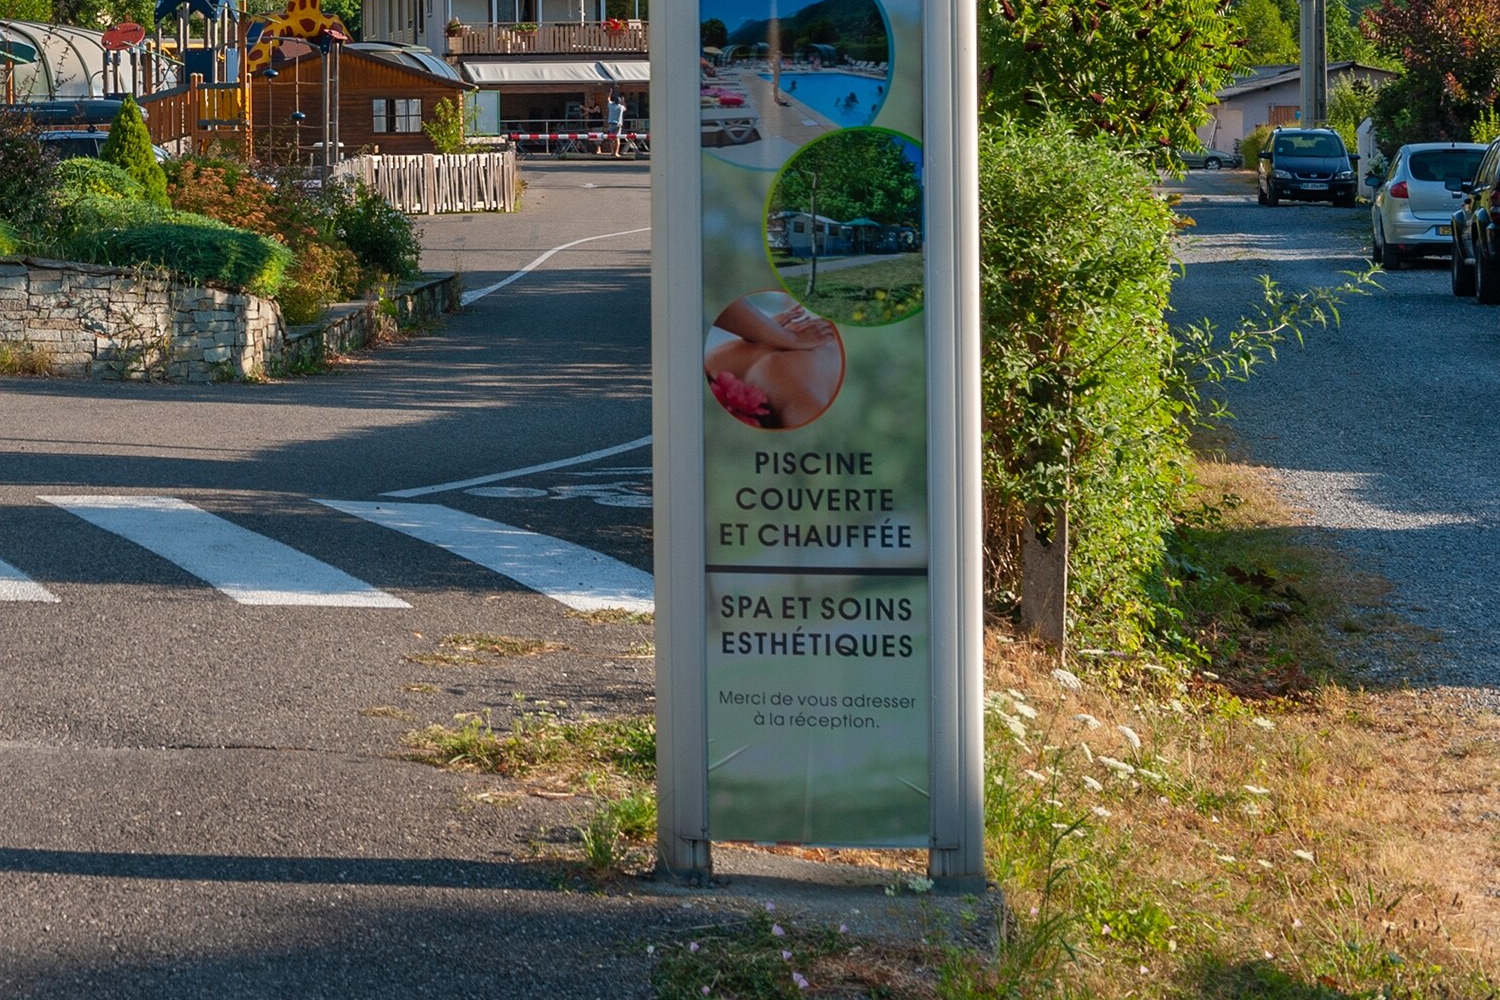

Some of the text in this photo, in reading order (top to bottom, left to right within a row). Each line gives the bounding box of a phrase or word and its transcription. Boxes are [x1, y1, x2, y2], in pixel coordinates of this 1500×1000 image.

[755, 451, 873, 475] PISCINE
[735, 486, 894, 512] COUVERTE
[719, 517, 913, 549] ET CHAUFFÉE
[720, 594, 913, 622] SPA ET SOINS
[721, 625, 914, 658] ESTHÉTIQUES
[718, 689, 917, 709] Merci de vous adresser
[753, 710, 881, 730] à la réception.
